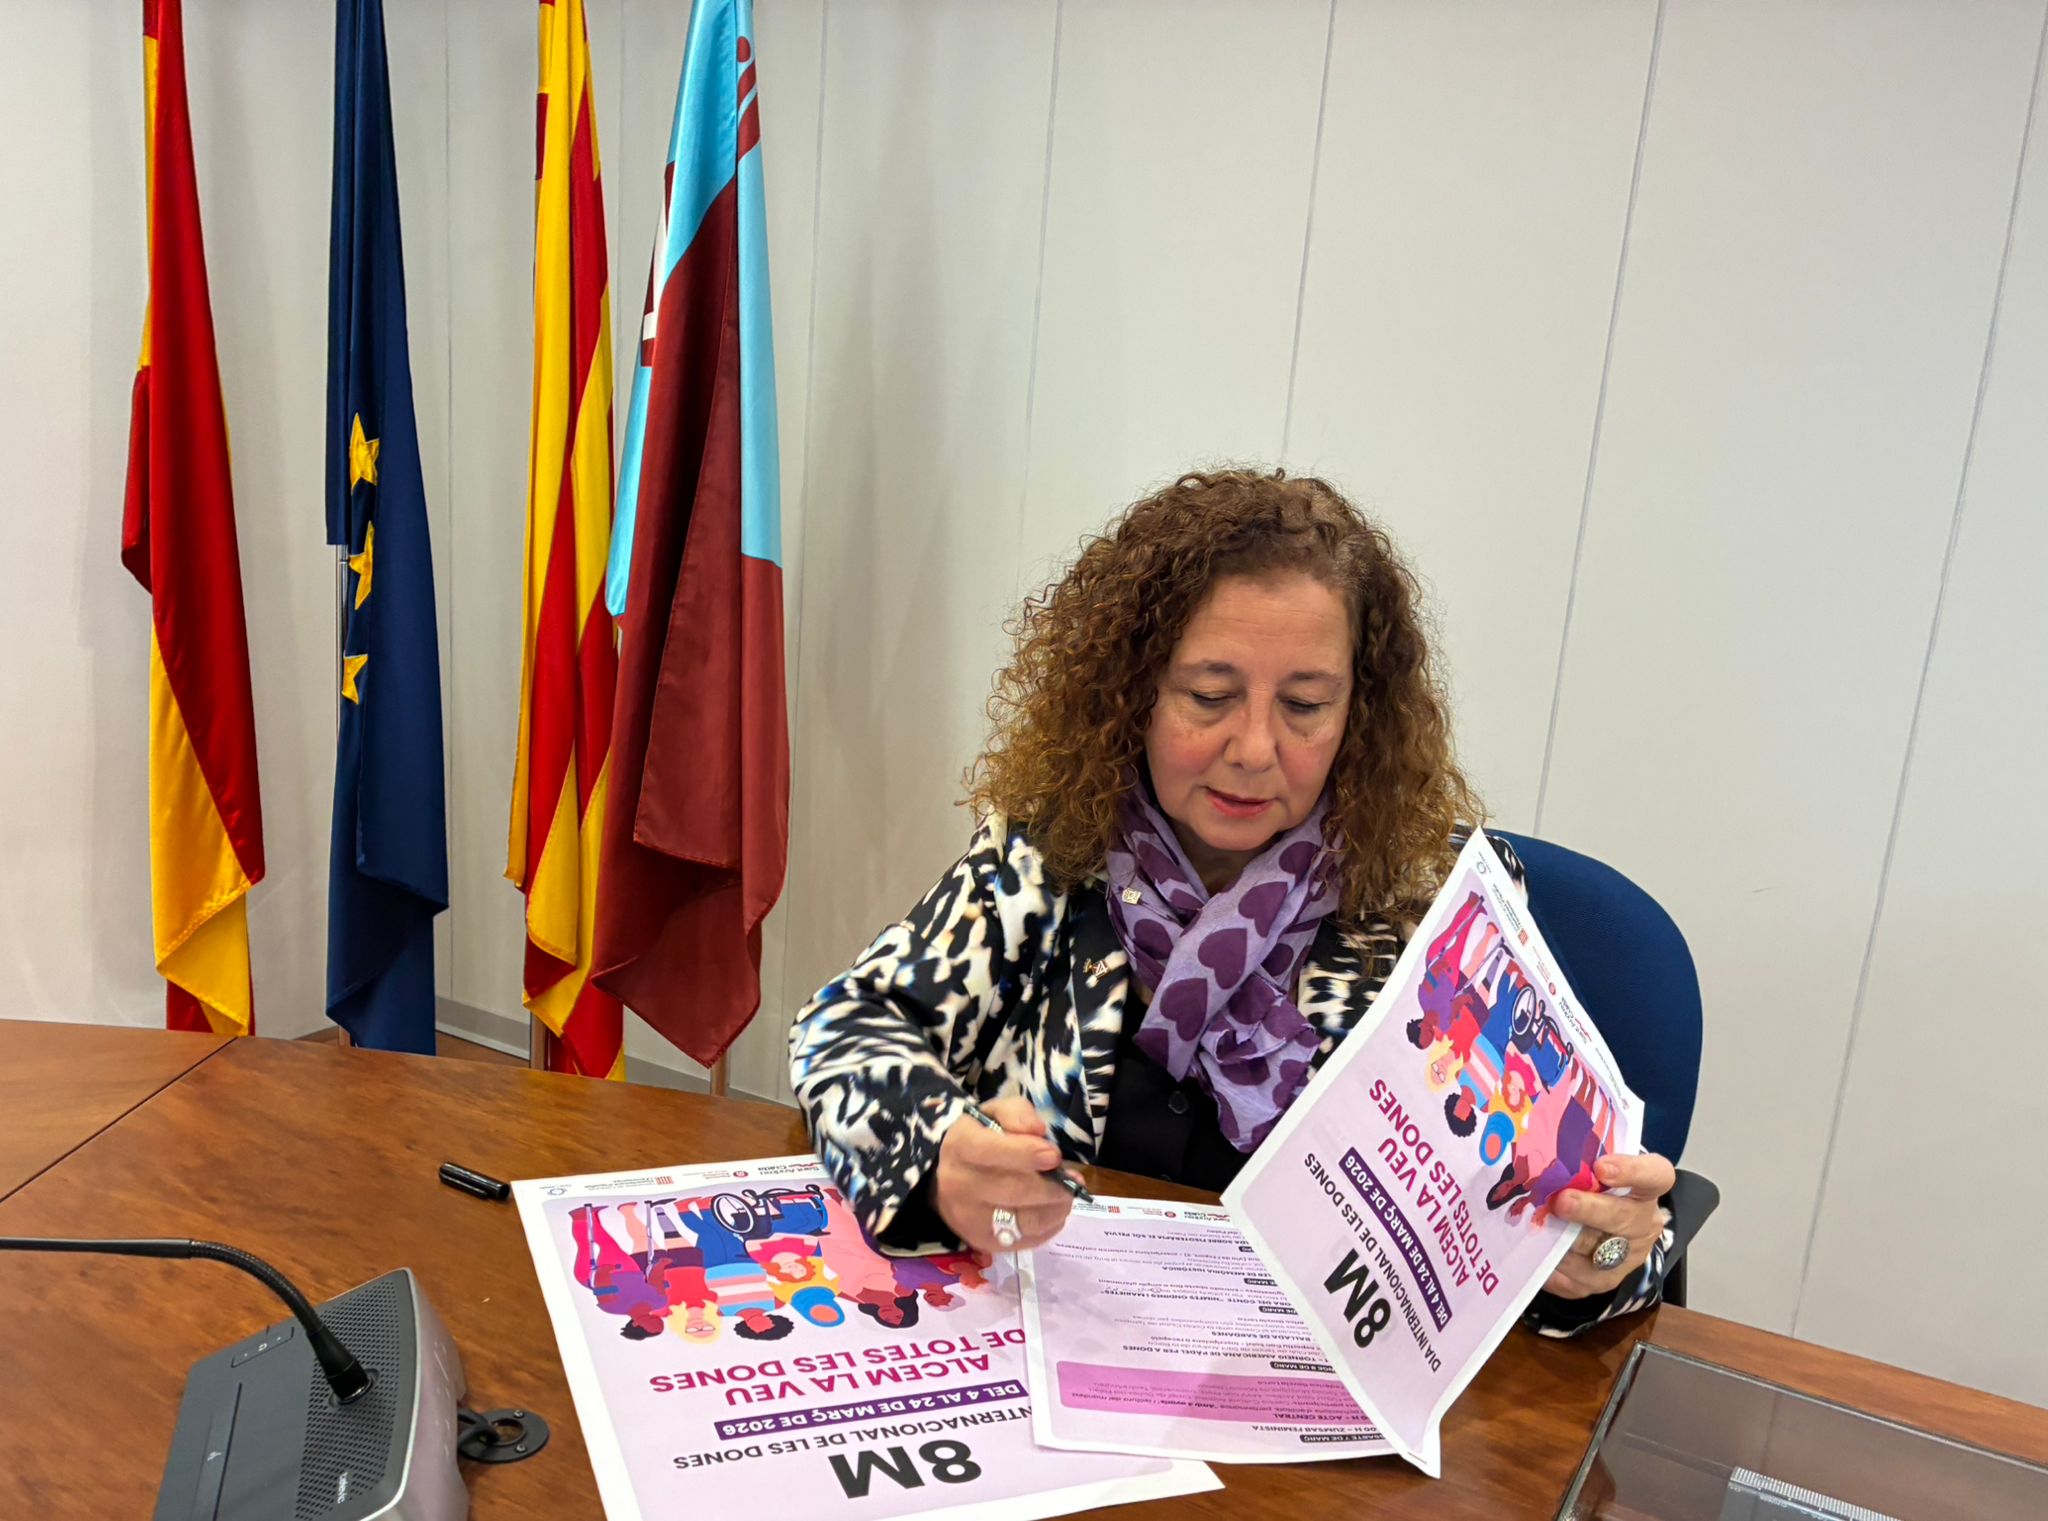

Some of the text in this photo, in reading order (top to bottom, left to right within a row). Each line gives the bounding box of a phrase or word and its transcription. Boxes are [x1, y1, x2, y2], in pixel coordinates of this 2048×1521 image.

[1369, 1079, 1499, 1296] DE TOTES LES DONES
[1377, 1138, 1470, 1287] ALCEM LA VEU
[1304, 1153, 1441, 1373] DIA INTERNACIONAL DE LES DONES
[1344, 1155, 1449, 1326] DEL 4 AL 24 DE MARÇ DE 2026
[1323, 1248, 1391, 1348] 8M
[649, 1328, 1026, 1393] DE TOTES LES DONES
[725, 1354, 989, 1406] ALCEM LA VEU
[673, 1405, 1032, 1469] NTERNACIONAL DE LES DONES
[722, 1383, 1021, 1435] DEL 4 AL 24 DE MARÇ DE 2026
[828, 1439, 982, 1499] 8M
